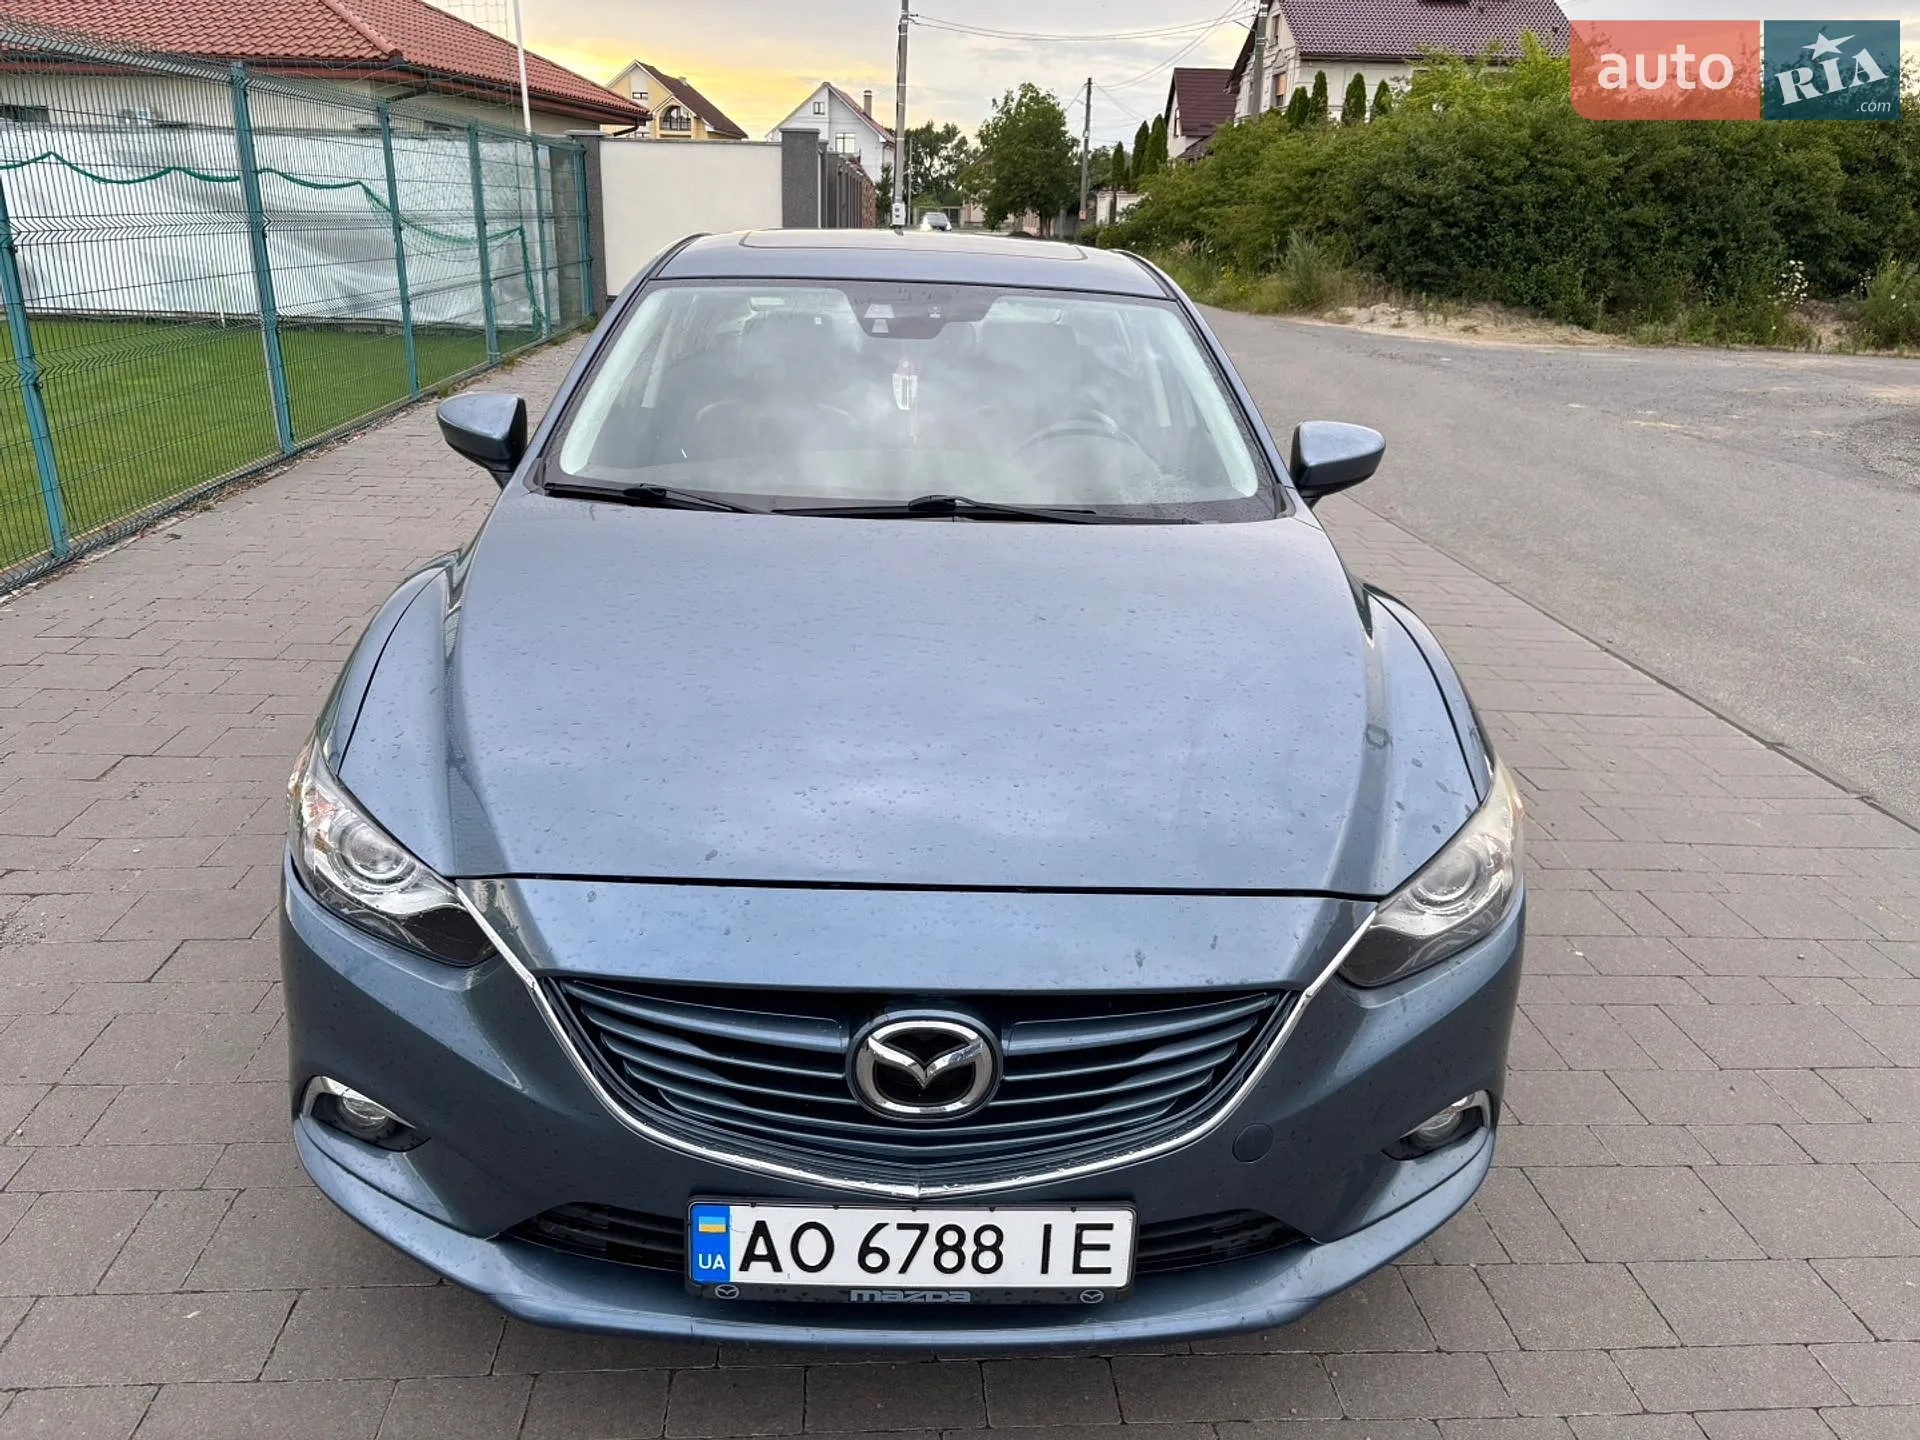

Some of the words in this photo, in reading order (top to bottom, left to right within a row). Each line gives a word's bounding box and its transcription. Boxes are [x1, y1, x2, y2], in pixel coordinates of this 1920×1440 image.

[698, 1254, 726, 1270] UA
[738, 1220, 835, 1273] AO
[857, 1222, 1004, 1274] 6788
[1040, 1222, 1114, 1274] IE
